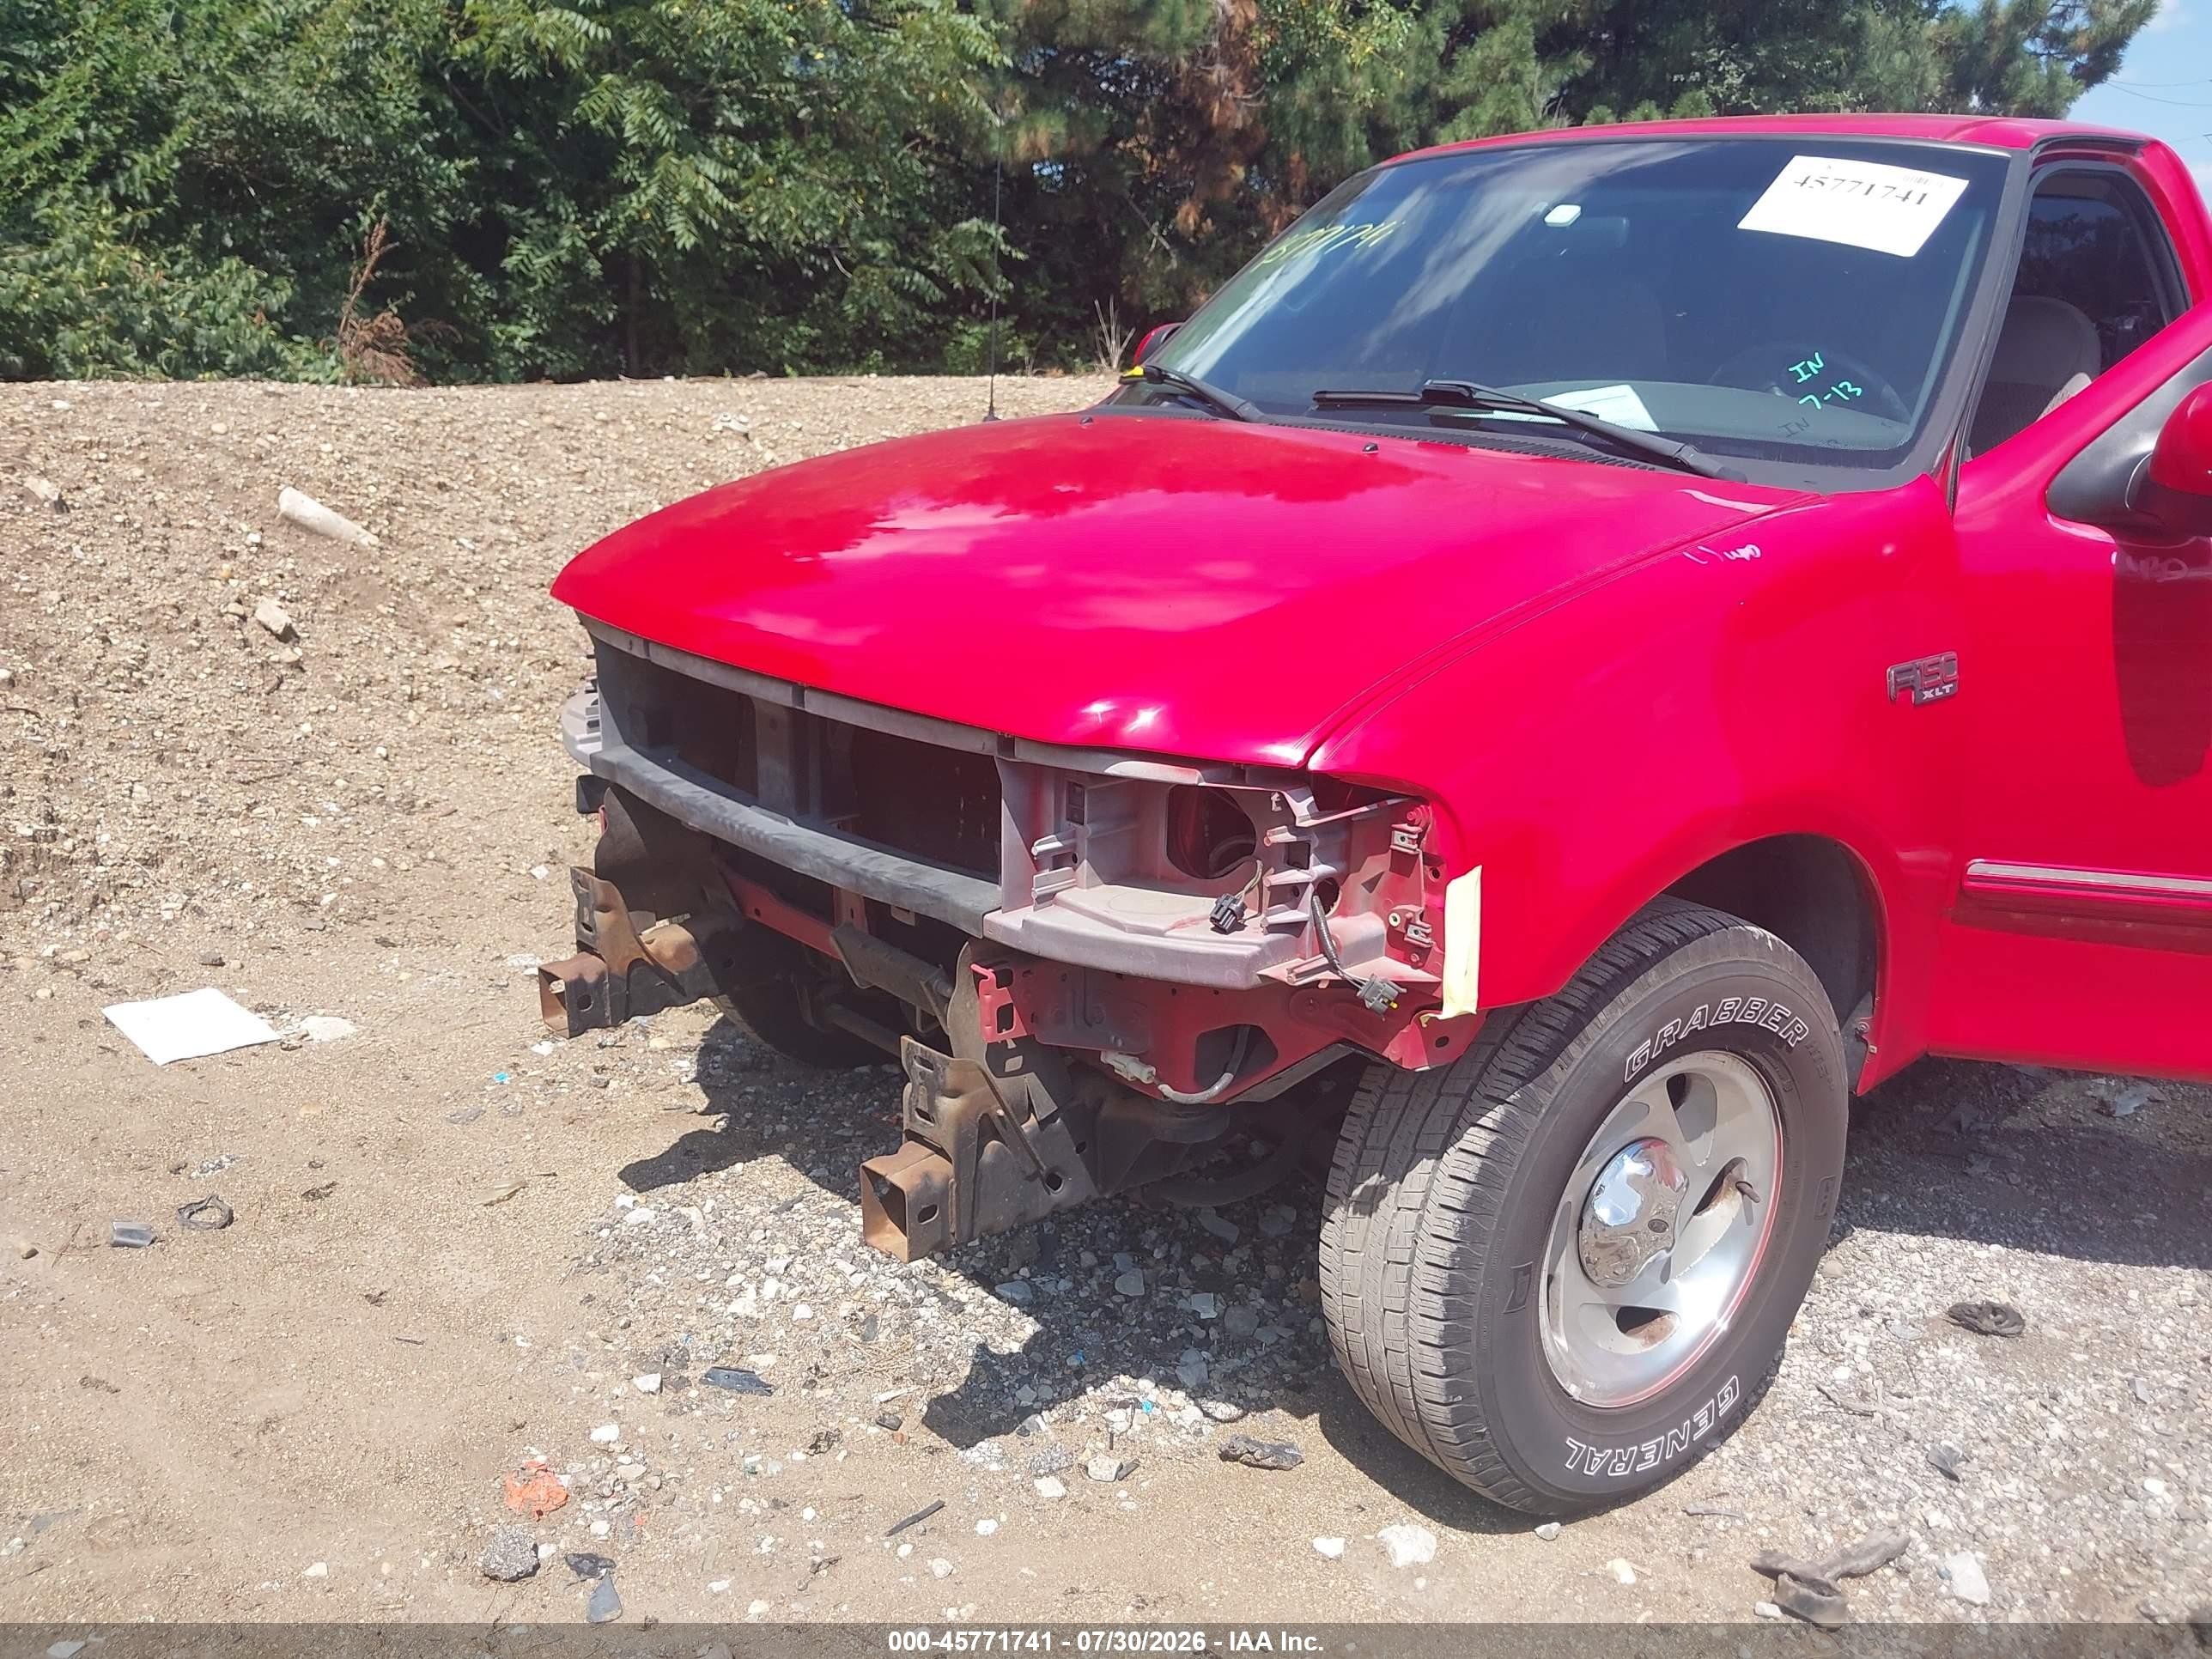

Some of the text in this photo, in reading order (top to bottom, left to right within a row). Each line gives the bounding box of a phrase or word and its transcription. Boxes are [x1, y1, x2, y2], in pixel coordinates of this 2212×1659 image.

[1793, 174, 1929, 205] 45771741
[1788, 351, 1825, 384] IN
[1798, 380, 1863, 410] 7-13
[1923, 684, 1954, 701] XLT
[1624, 996, 1809, 1084] GRABBER
[1565, 1374, 1740, 1477] GENERAL
